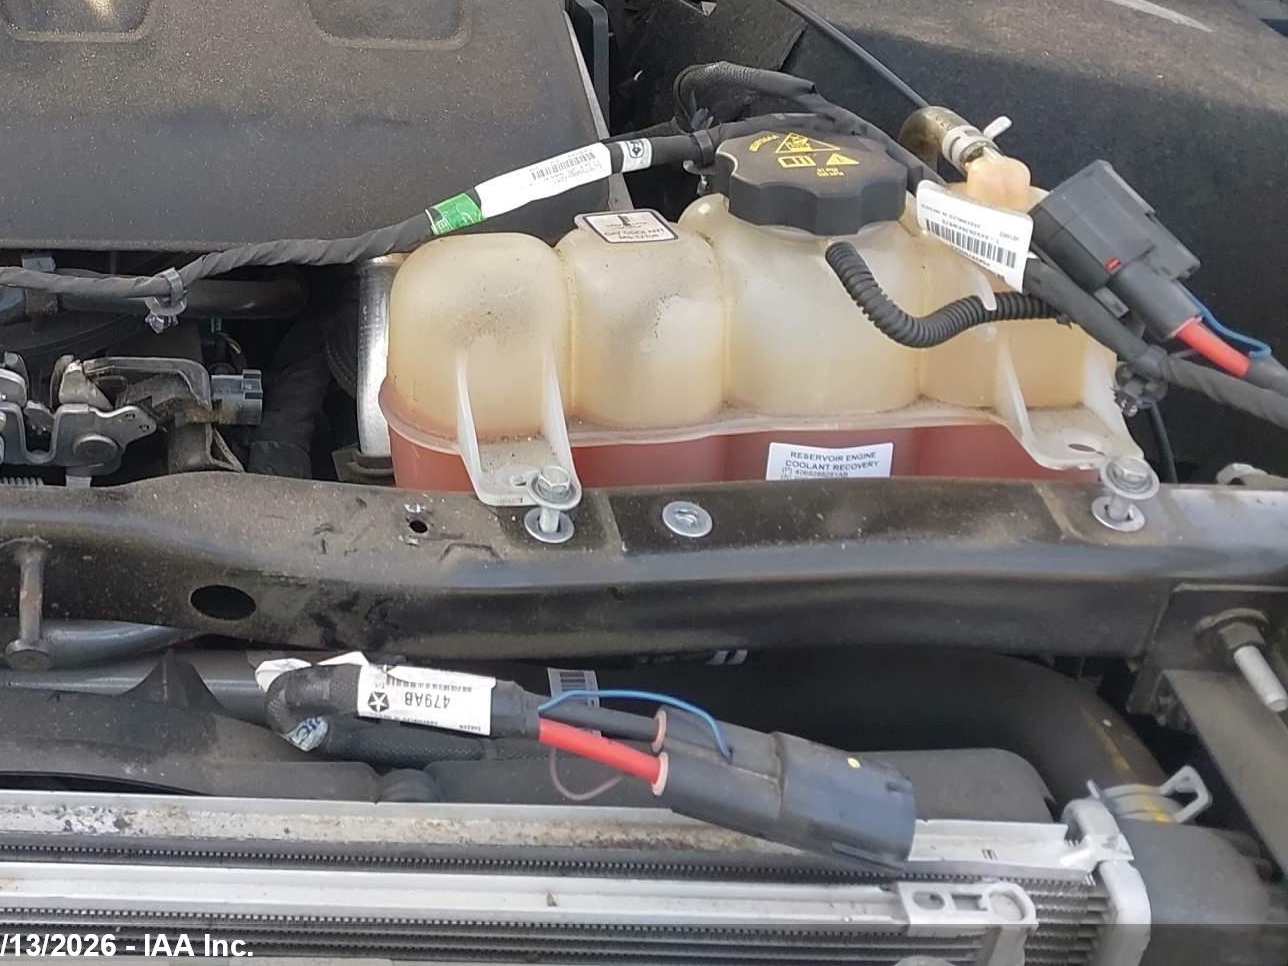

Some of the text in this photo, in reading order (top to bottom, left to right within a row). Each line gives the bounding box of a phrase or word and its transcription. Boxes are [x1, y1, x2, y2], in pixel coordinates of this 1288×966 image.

[790, 451, 877, 462] RESERVOIR ENGINE
[785, 459, 880, 472] COOLANT RECOVERY
[404, 693, 451, 709] 479AB
